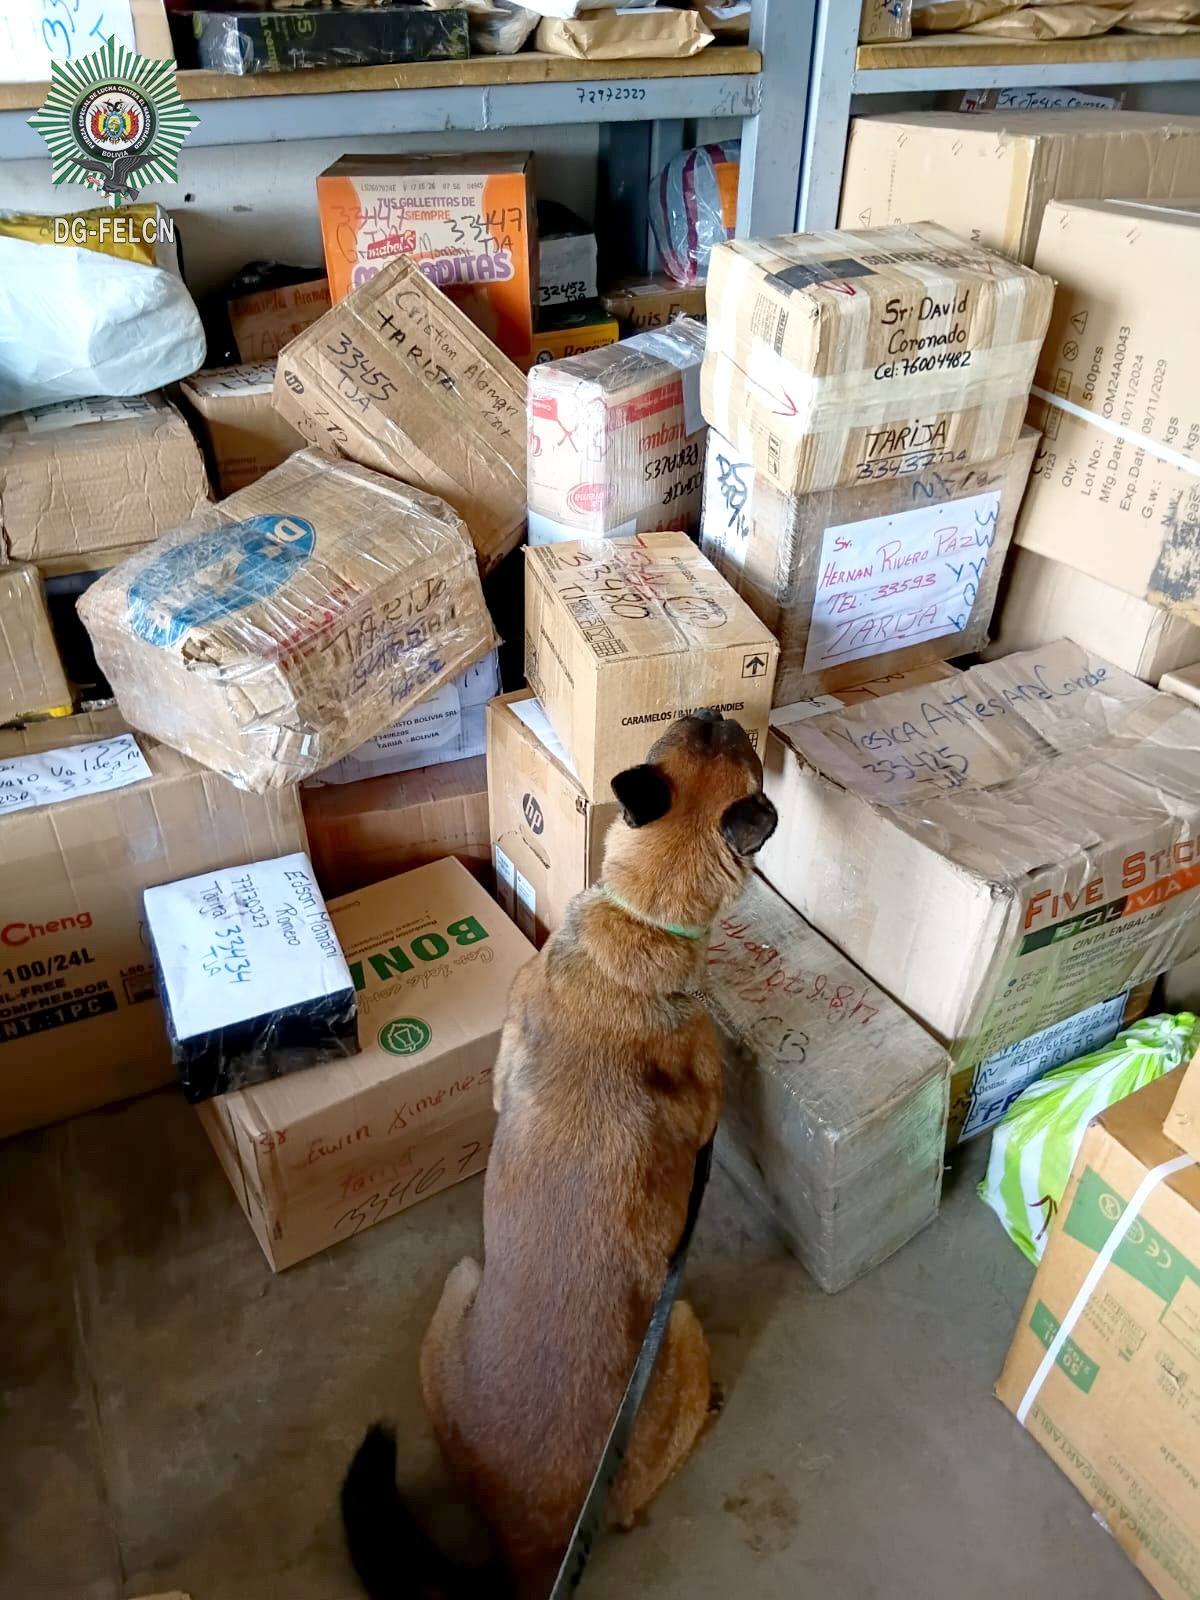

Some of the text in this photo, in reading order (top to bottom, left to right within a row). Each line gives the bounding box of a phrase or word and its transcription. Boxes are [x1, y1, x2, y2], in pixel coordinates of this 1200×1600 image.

[377, 196, 476, 208] TUS GALLETITAS DE
[405, 209, 451, 221] SIEMPRE
[444, 207, 523, 243] 33447
[538, 281, 587, 300] 32452
[888, 328, 968, 356] Coronado
[327, 331, 399, 402] 33455
[1141, 358, 1169, 435] 09/11/2029
[1061, 345, 1105, 489] Qty: 500pcs
[1043, 452, 1058, 481] 0123
[1080, 469, 1096, 497] Lot
[818, 561, 873, 591] HERNAN
[933, 526, 977, 557] PAZ
[870, 573, 937, 601] 33593
[413, 712, 444, 725] BOLIVIA
[621, 711, 673, 728] CARAMELOS
[410, 731, 440, 744] BOLIVIA
[527, 799, 543, 832] hp
[1023, 836, 1200, 929] FIVE STIC
[1, 911, 93, 947] Cheng
[1072, 933, 1106, 951] CINTA
[4, 947, 96, 985] 100/24L
[0, 976, 67, 1004] IL-FREE
[0, 979, 110, 1018] OMPRESSOR
